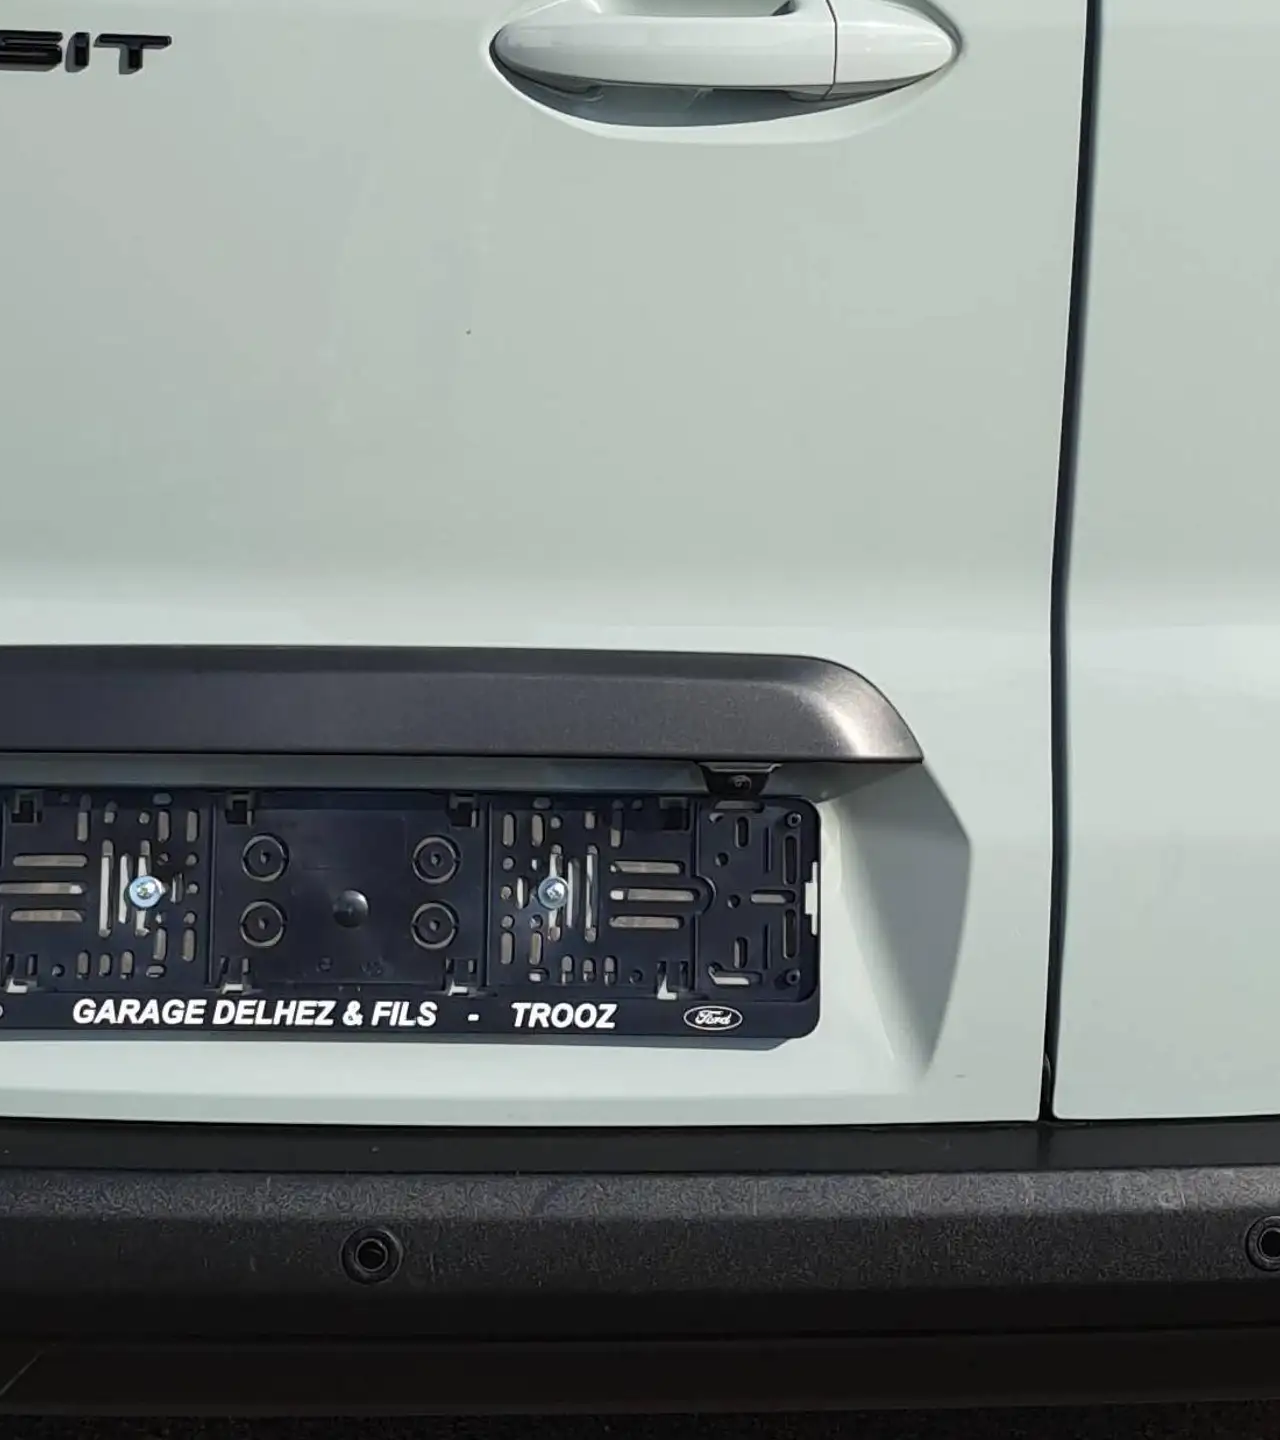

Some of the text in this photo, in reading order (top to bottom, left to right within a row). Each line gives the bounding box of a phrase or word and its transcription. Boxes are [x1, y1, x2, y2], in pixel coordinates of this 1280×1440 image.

[72, 998, 204, 1026] GARAGE
[212, 999, 334, 1027] DELHEZ
[342, 1001, 364, 1027] &
[371, 1001, 438, 1027] FILS
[511, 1002, 617, 1029] TROOZ
[695, 1008, 732, 1026] Ford
